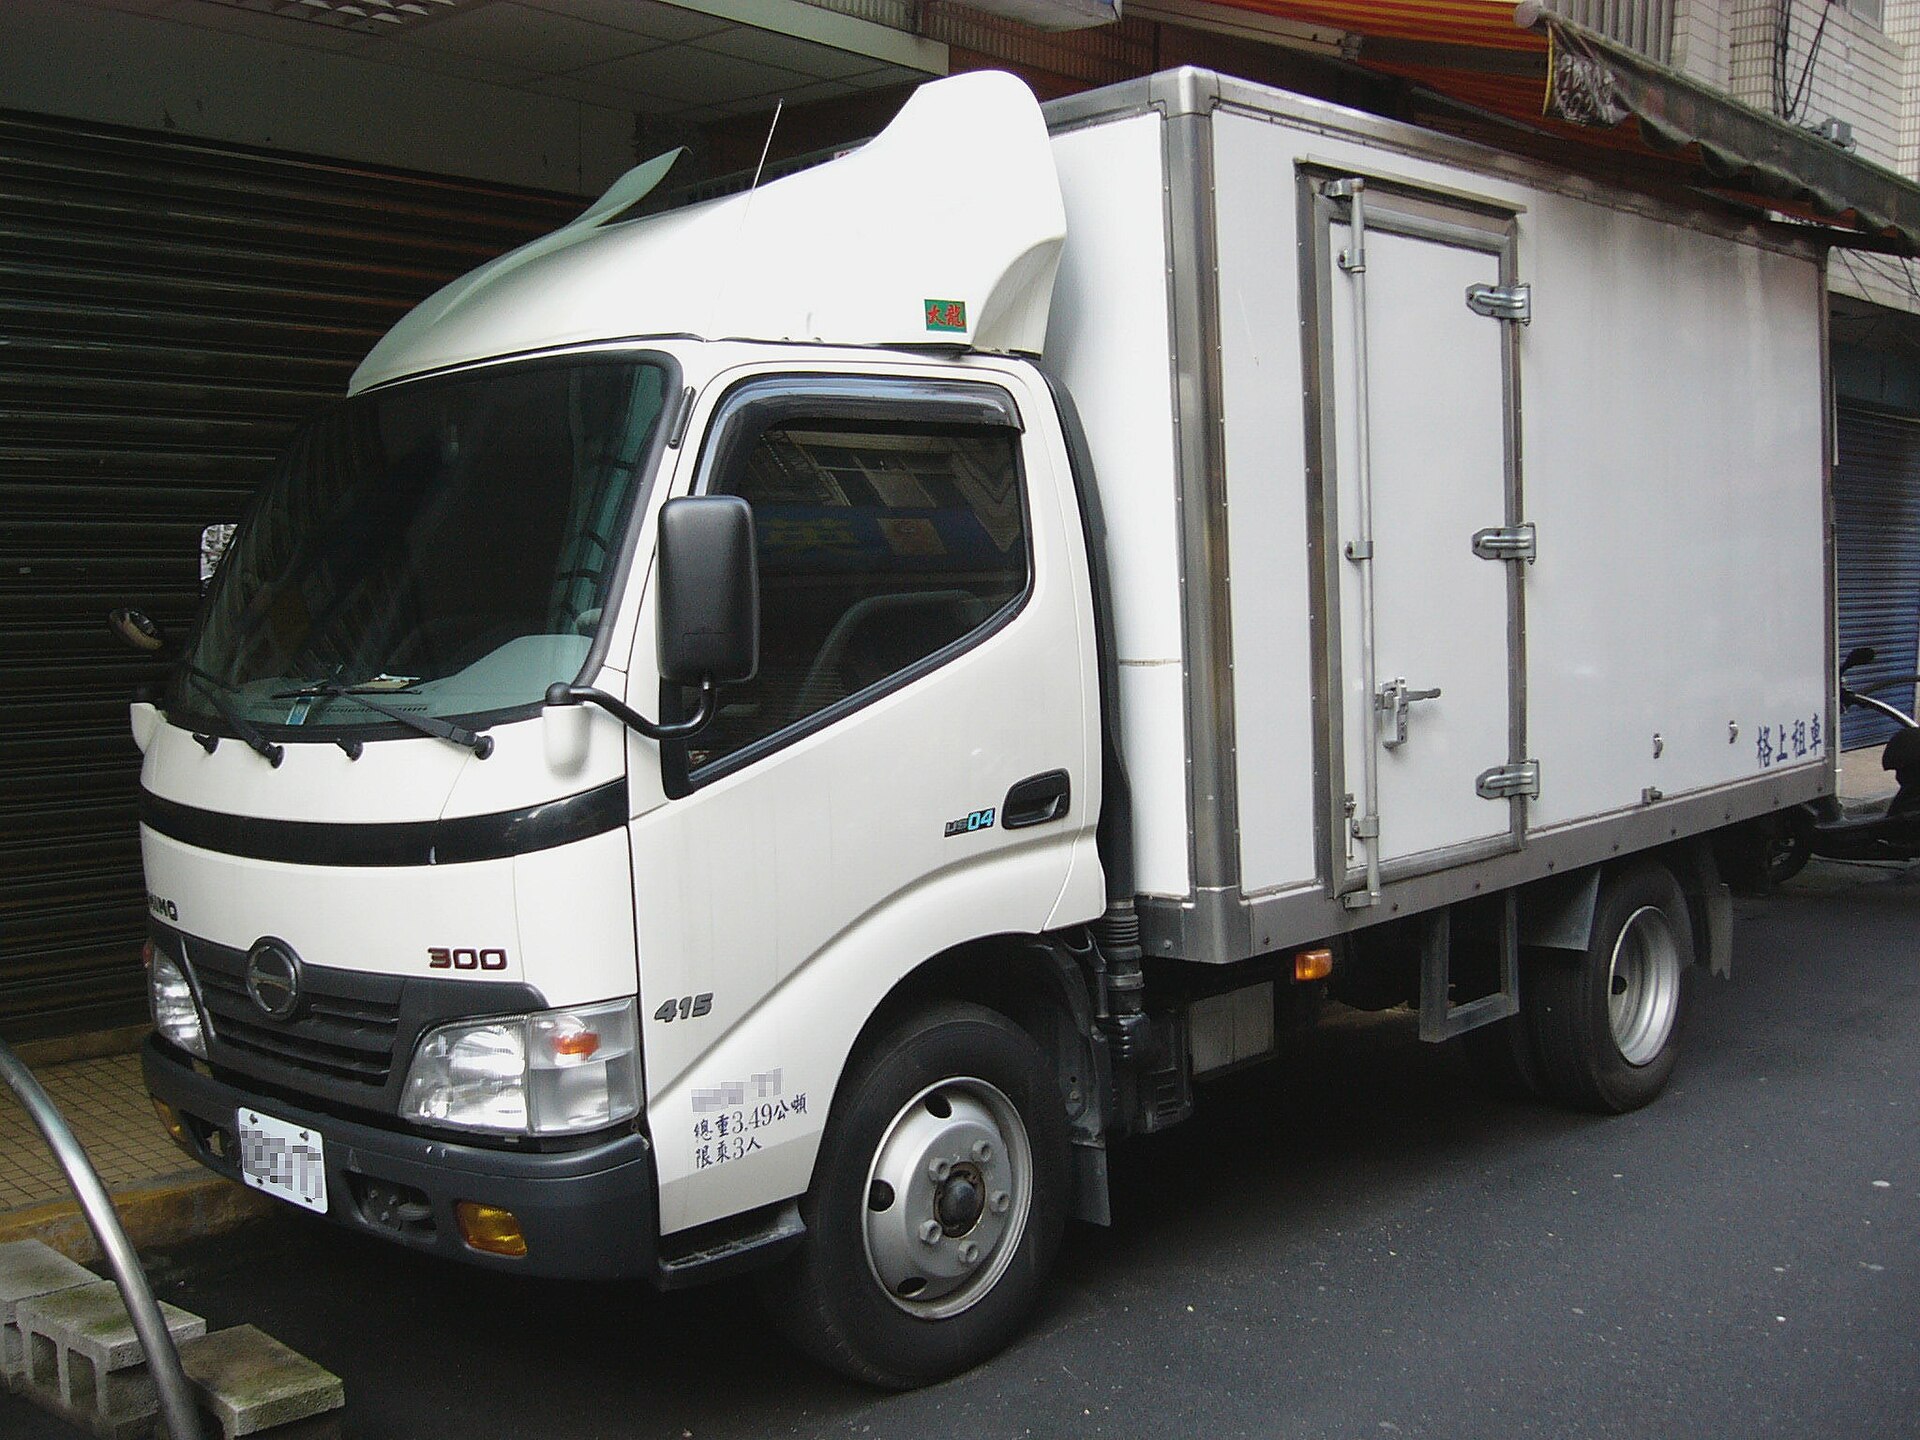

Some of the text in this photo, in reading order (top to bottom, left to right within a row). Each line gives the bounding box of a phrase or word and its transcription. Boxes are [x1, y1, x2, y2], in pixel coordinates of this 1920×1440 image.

[1756, 712, 1822, 768] 格上租車
[428, 947, 508, 970] 300
[654, 993, 713, 1023] 415
